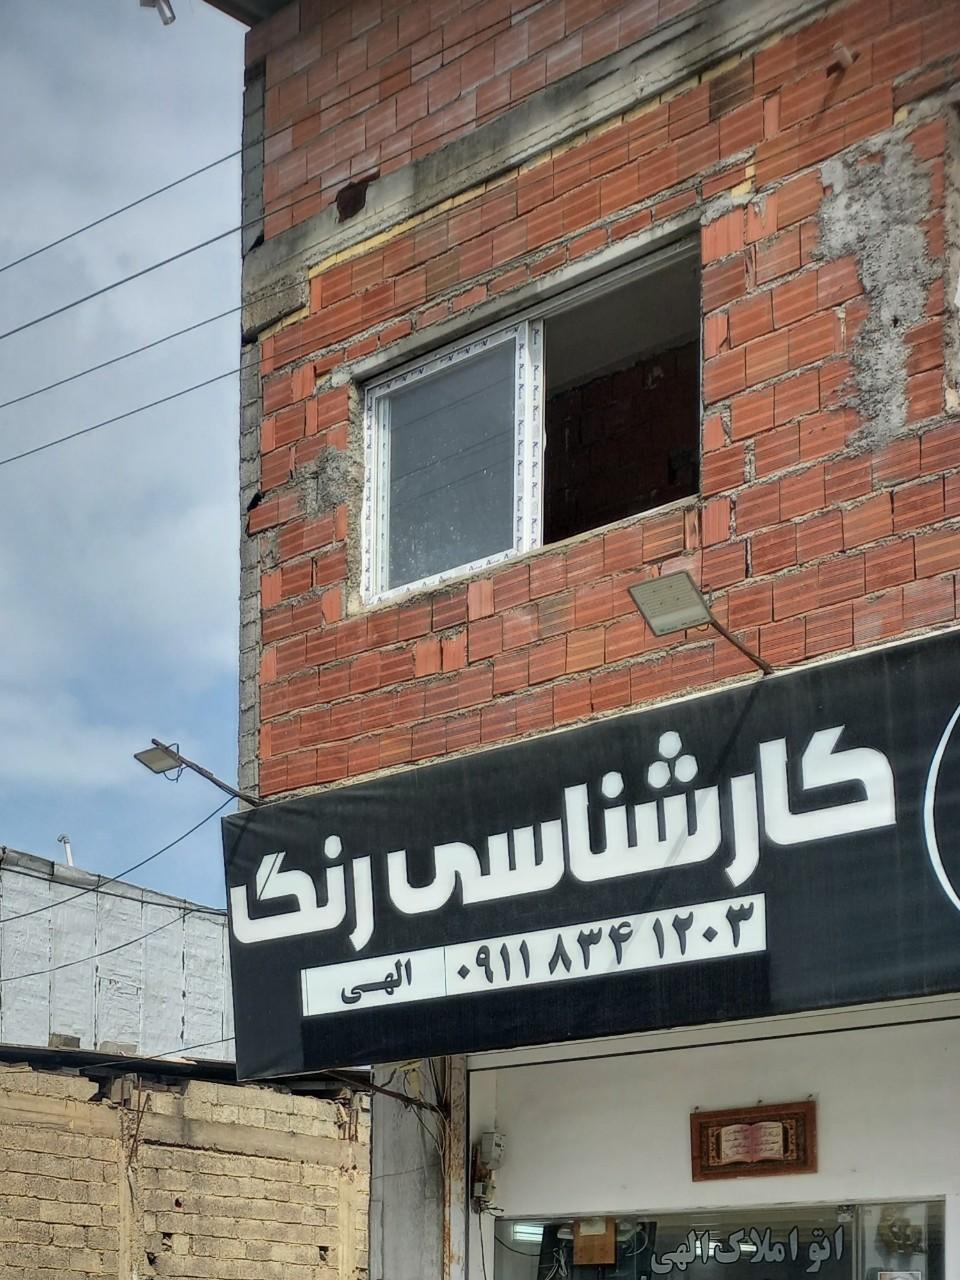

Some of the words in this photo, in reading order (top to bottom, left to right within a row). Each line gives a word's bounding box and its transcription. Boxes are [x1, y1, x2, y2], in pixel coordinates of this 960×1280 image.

[388, 725, 896, 915] کارشناسی
[230, 836, 374, 951] رنگ
[549, 920, 634, 974] ۸۳۴
[653, 901, 754, 958] ۱۲۰۳
[340, 960, 413, 1004] الهی
[456, 940, 531, 983] ۰۹۱۱
[650, 1228, 710, 1274] الهی
[714, 1226, 798, 1265] املاک
[806, 1225, 844, 1273] اتو
